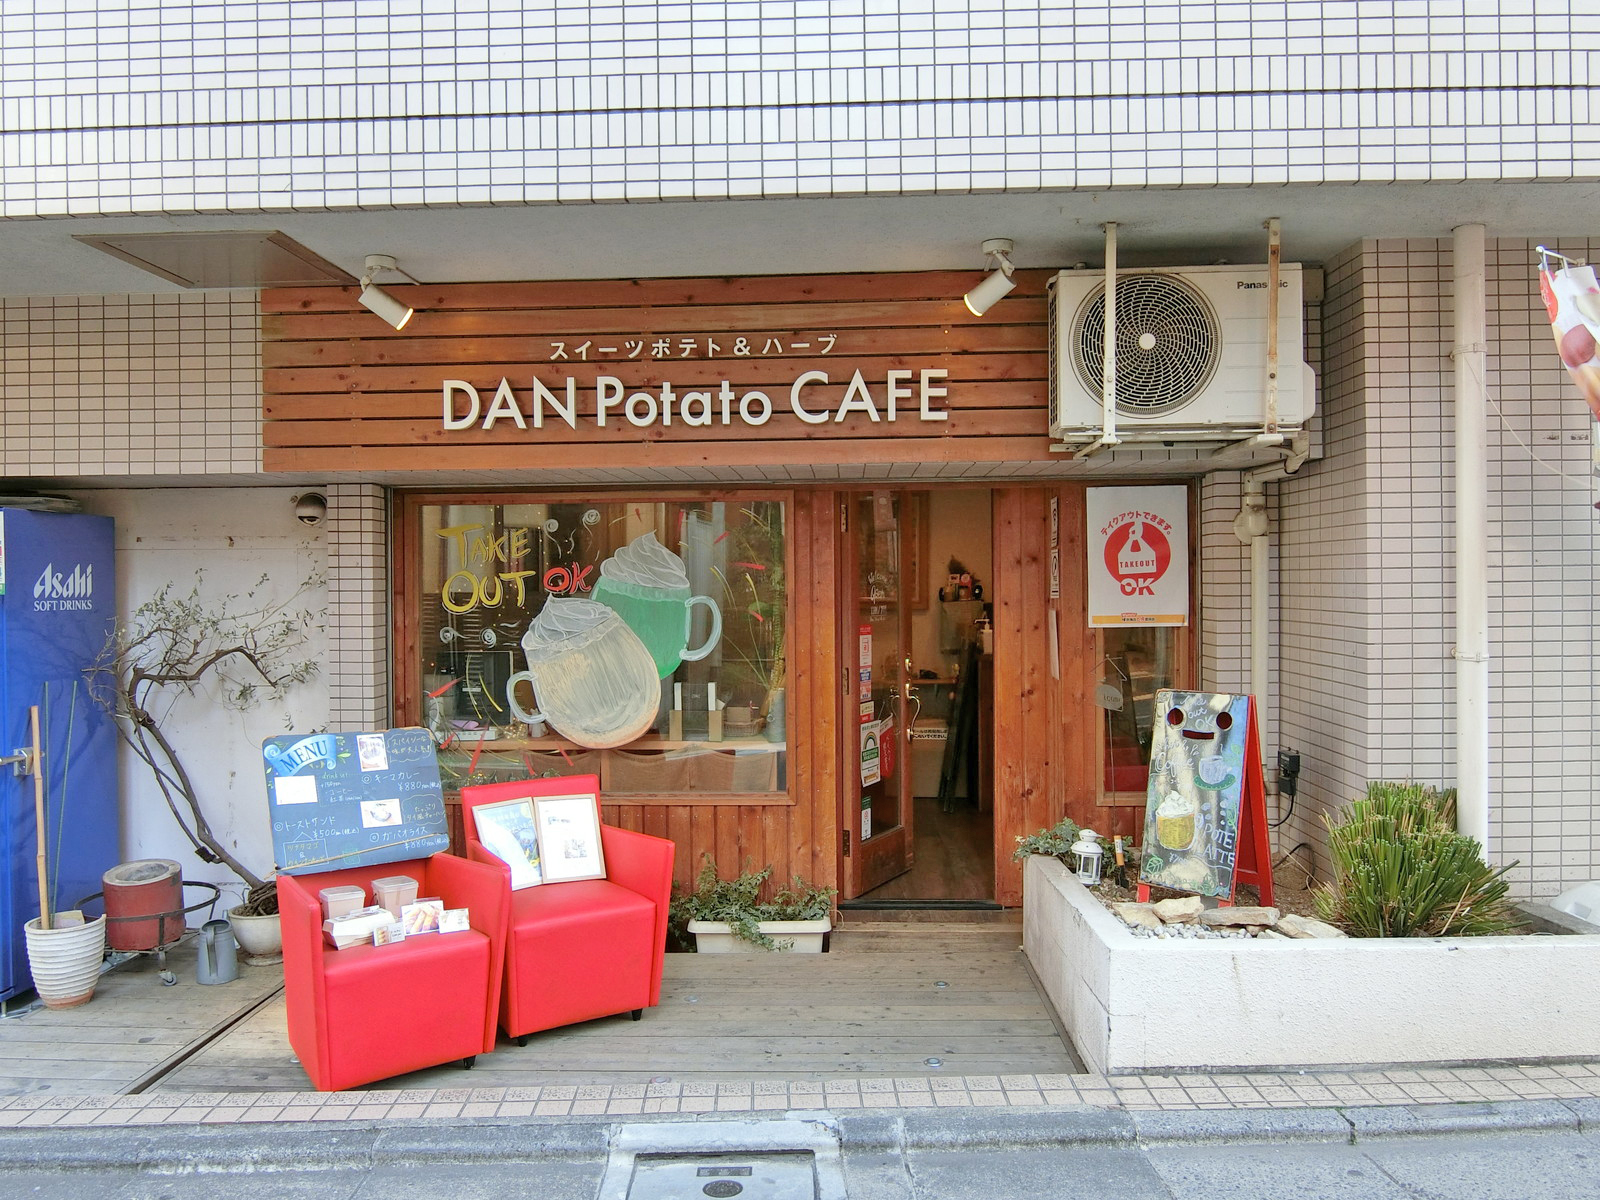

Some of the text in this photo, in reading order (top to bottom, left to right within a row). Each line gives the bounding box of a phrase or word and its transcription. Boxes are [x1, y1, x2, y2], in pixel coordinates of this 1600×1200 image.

[1237, 280, 1288, 289] Panasic
[442, 367, 950, 431] DAN Potato CAFE
[435, 523, 532, 568] TAKE
[1119, 559, 1155, 569] TAKEOUT
[33, 562, 93, 599] Asahi
[441, 561, 593, 615] OUT OK
[1119, 577, 1155, 596] OK
[33, 600, 93, 612] SOFT DRINKS
[1195, 714, 1215, 730] OK
[280, 740, 328, 773] MENU
